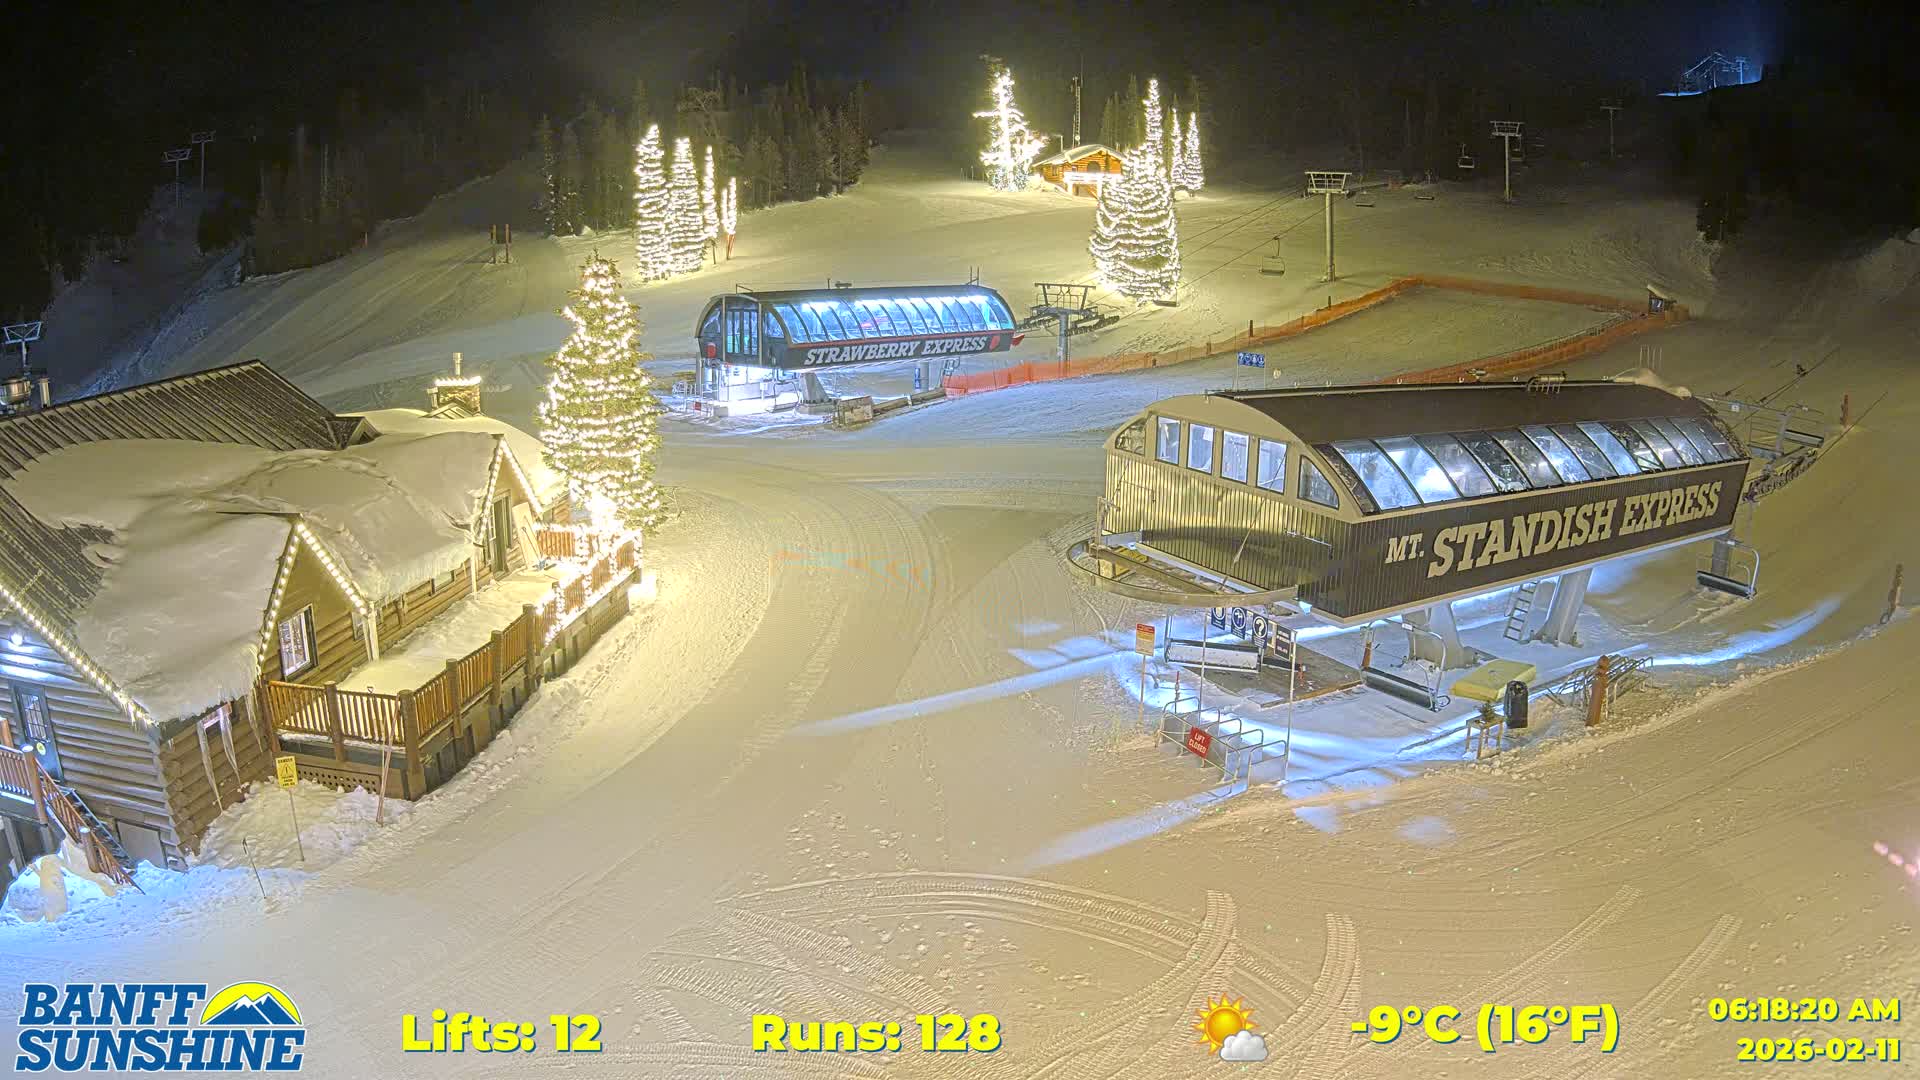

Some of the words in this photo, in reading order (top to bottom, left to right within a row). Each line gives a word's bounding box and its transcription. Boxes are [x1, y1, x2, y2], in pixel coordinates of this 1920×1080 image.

[805, 341, 918, 366] STRAWBERRY
[921, 336, 987, 355] EXPRESS
[1384, 532, 1425, 564] MT.
[1427, 498, 1618, 578] STANDISH
[1618, 480, 1722, 536] EXPRESS
[1188, 738, 1206, 754] CLOSED
[1194, 732, 1205, 744] LIFT
